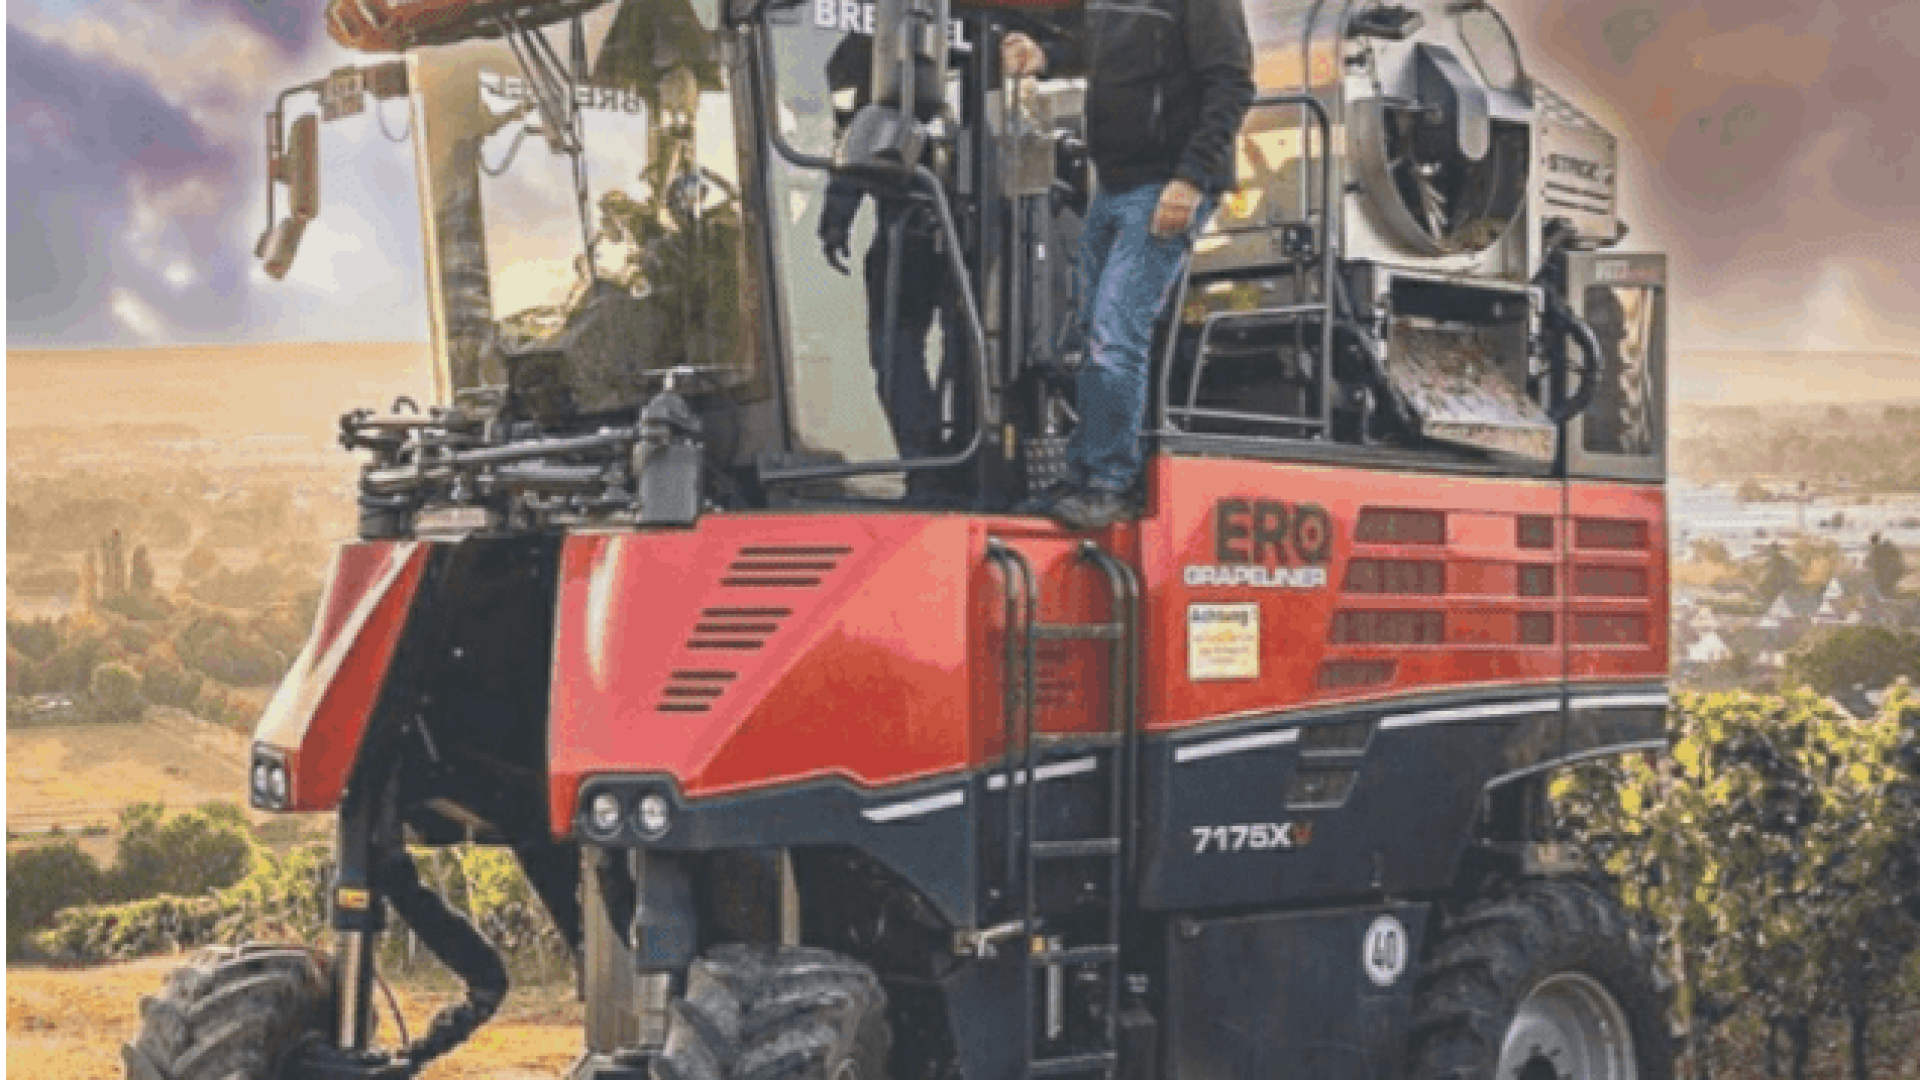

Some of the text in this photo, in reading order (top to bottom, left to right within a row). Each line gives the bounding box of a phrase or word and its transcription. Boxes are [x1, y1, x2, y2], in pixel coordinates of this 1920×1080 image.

[814, 0, 974, 51] BREL
[1216, 498, 1331, 565] ERO
[1183, 566, 1326, 588] GRAPELINER
[1371, 930, 1397, 970] 40
